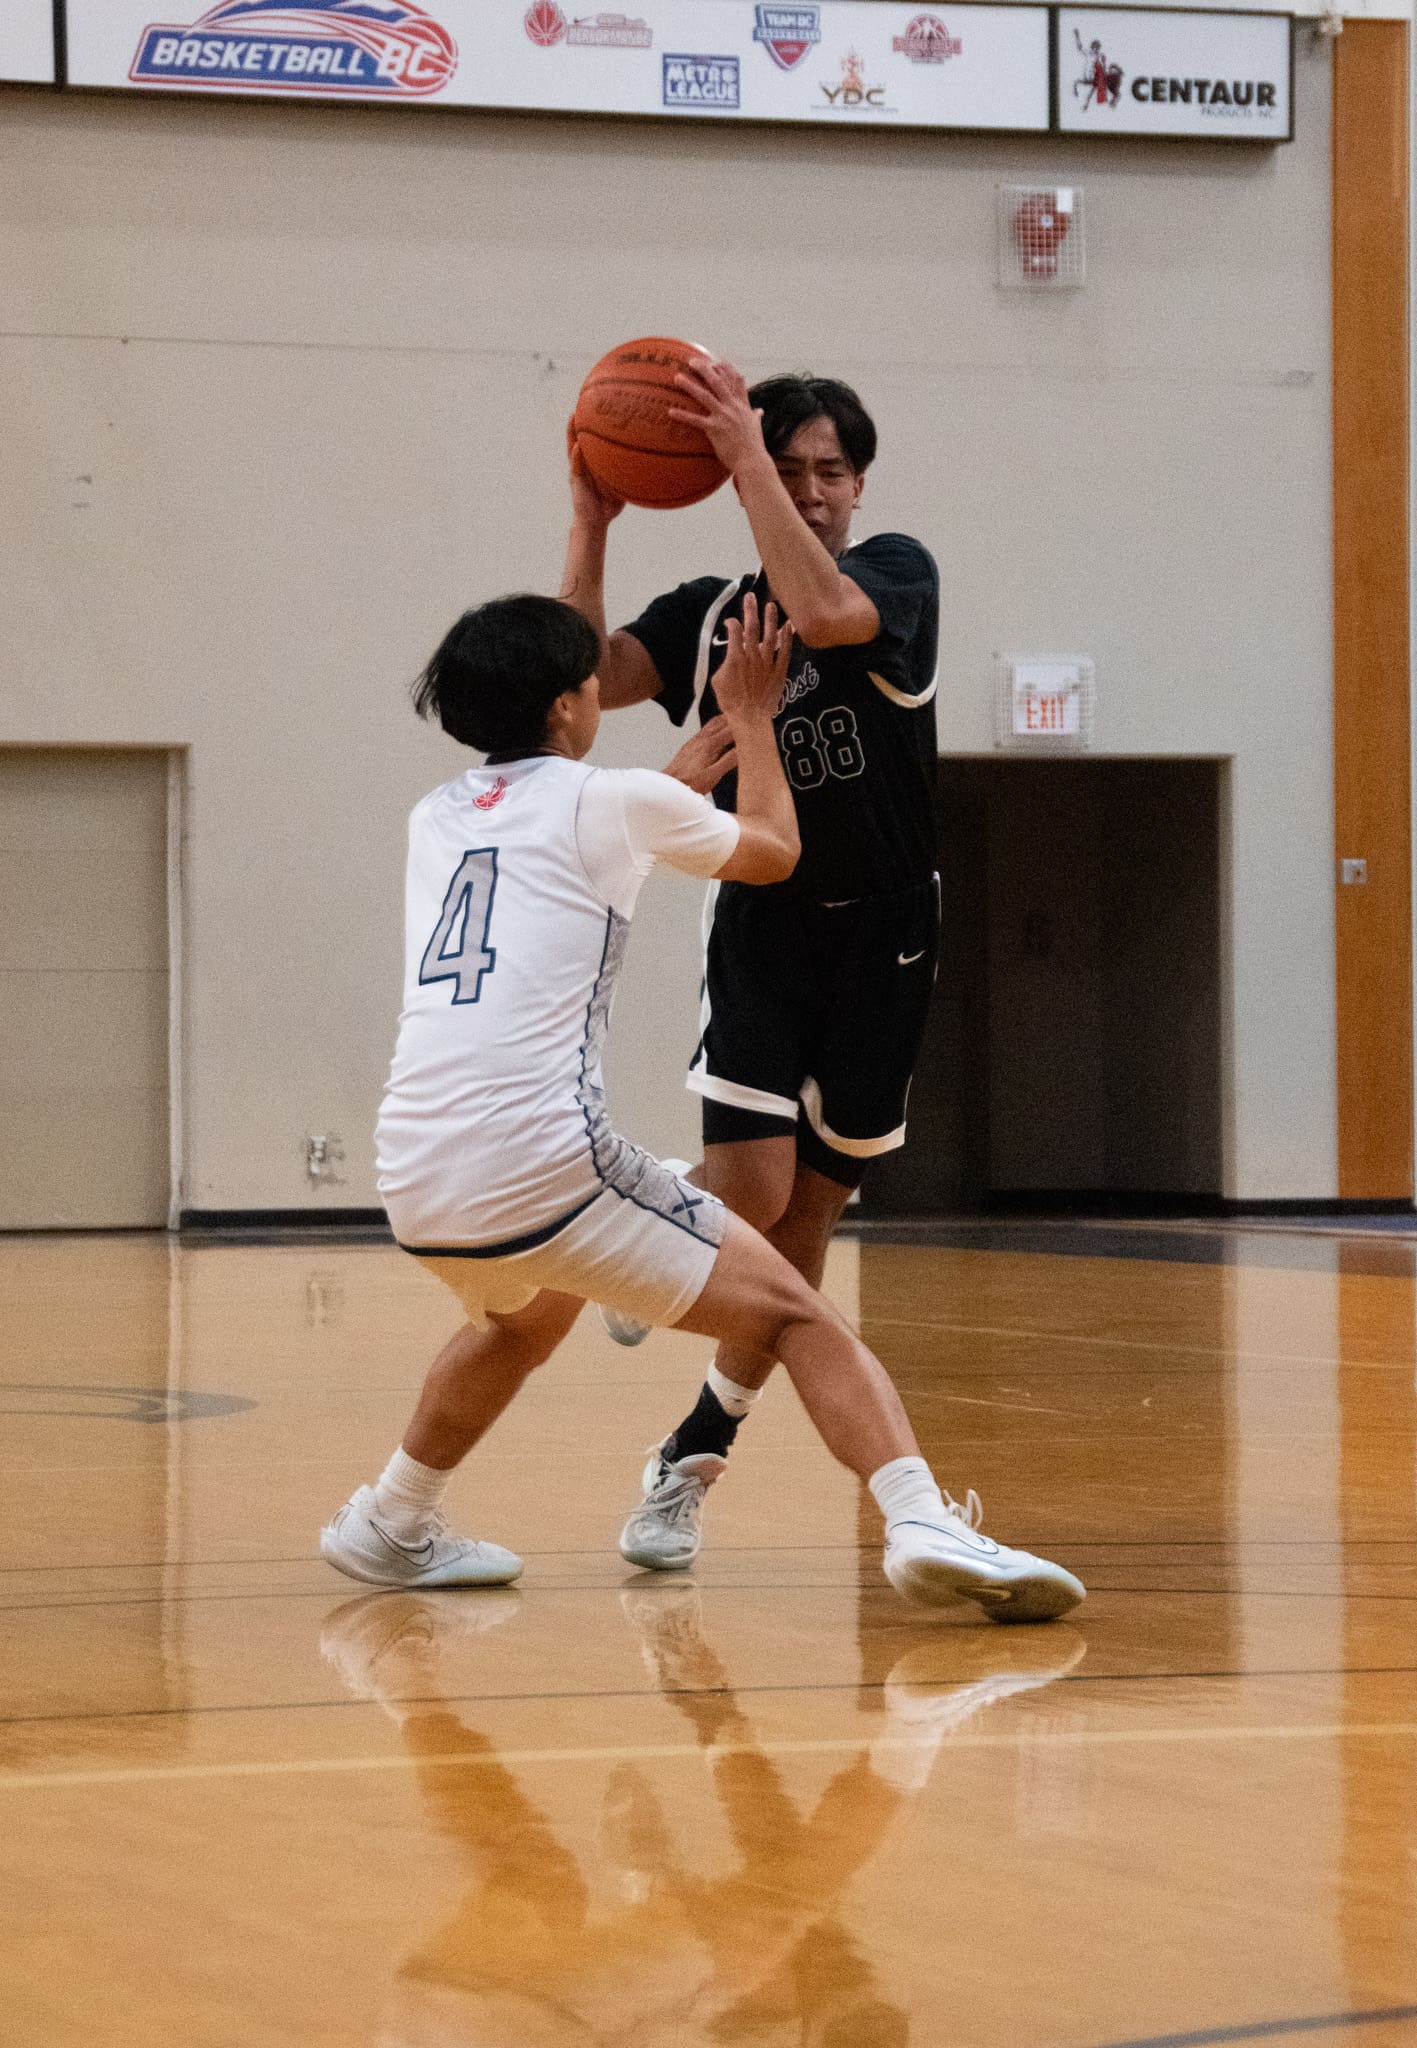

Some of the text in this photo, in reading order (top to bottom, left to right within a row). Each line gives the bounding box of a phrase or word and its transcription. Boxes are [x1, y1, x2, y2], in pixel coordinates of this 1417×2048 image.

[766, 13, 796, 27] TEAM
[151, 37, 443, 78] BASKETBALL BC
[667, 64, 738, 83] METRO
[667, 80, 738, 100] LEAGUE
[821, 86, 886, 106] YDC
[1131, 76, 1277, 107] CENTAUR
[782, 706, 865, 790] 88
[419, 847, 499, 1006] 4
